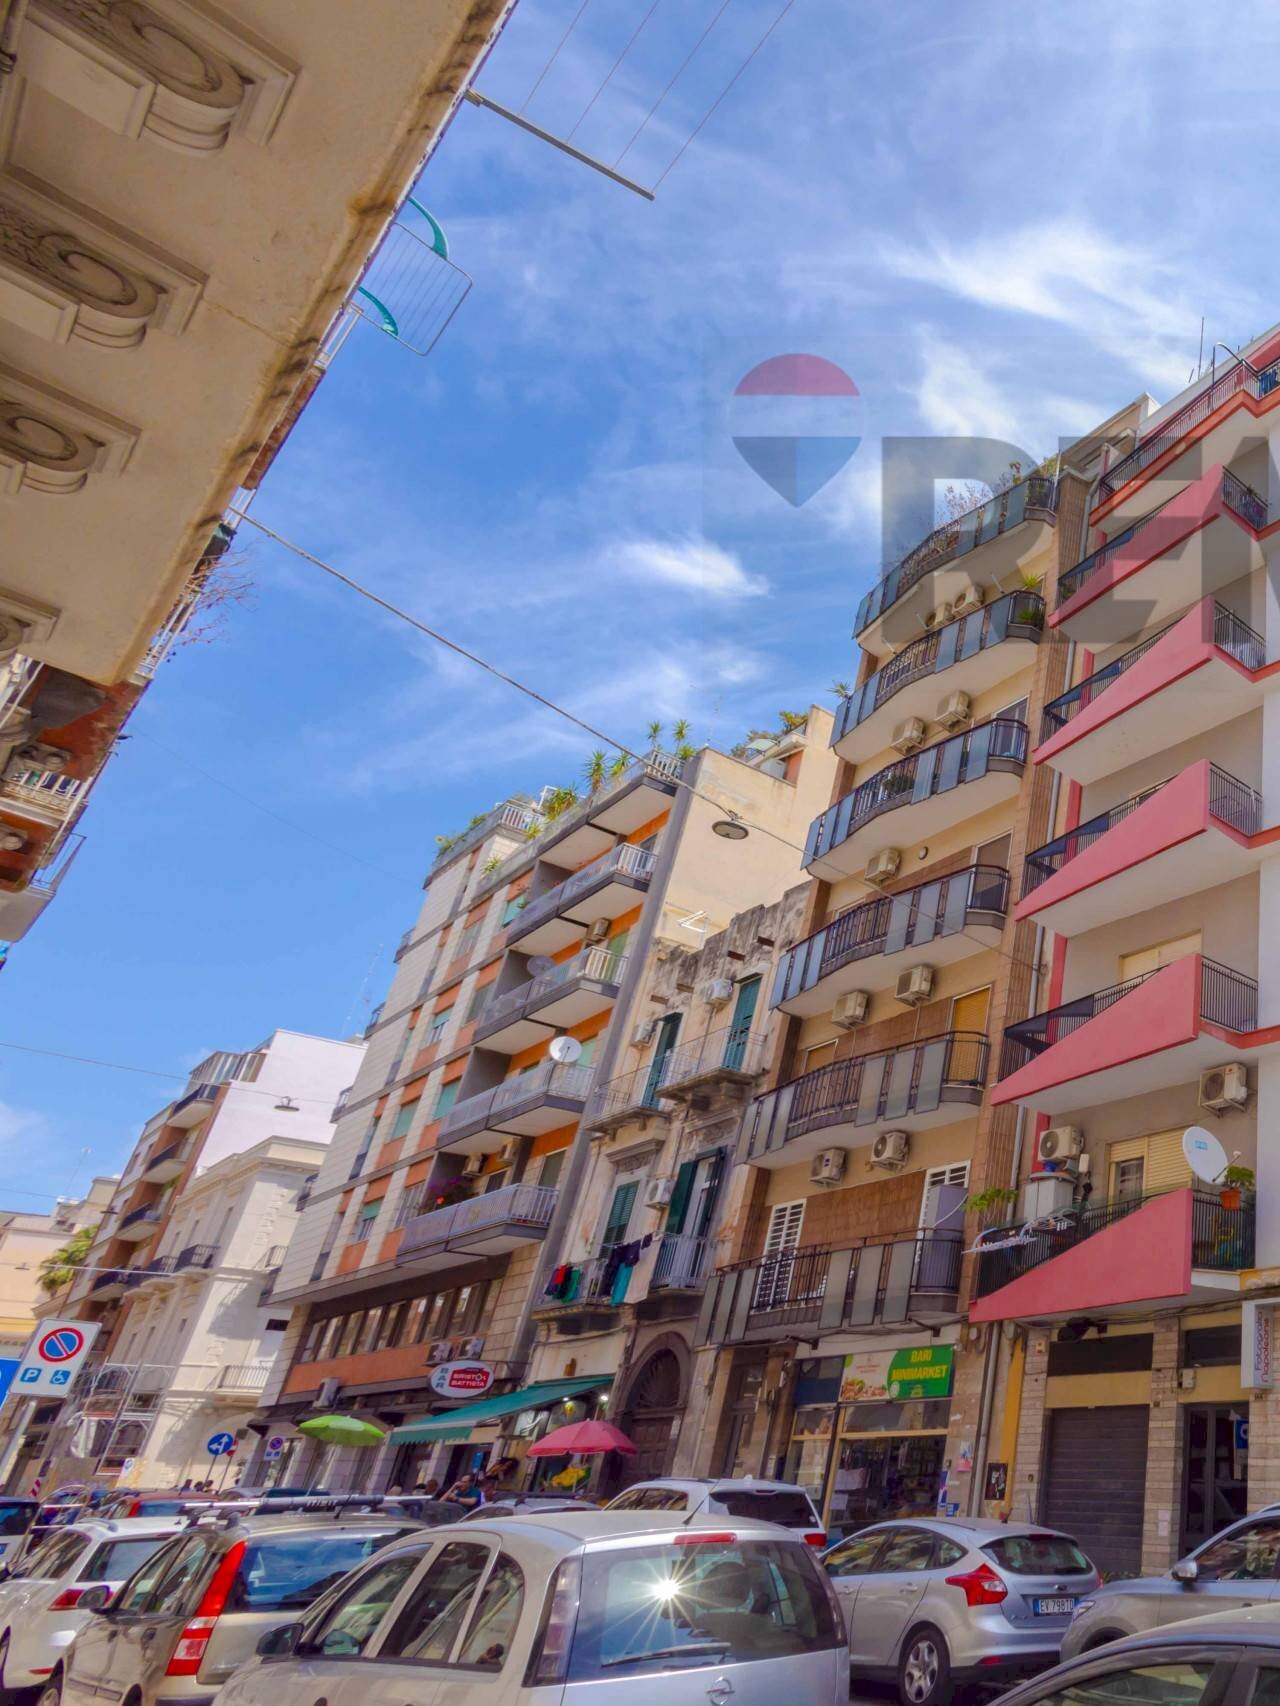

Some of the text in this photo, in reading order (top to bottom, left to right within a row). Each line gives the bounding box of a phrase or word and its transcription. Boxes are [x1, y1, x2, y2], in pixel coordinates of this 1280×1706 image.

[1255, 1311, 1264, 1371] Fotografia
[910, 1348, 932, 1363] BARI
[24, 1369, 39, 1381] P
[891, 1365, 948, 1381] MINIMARKET
